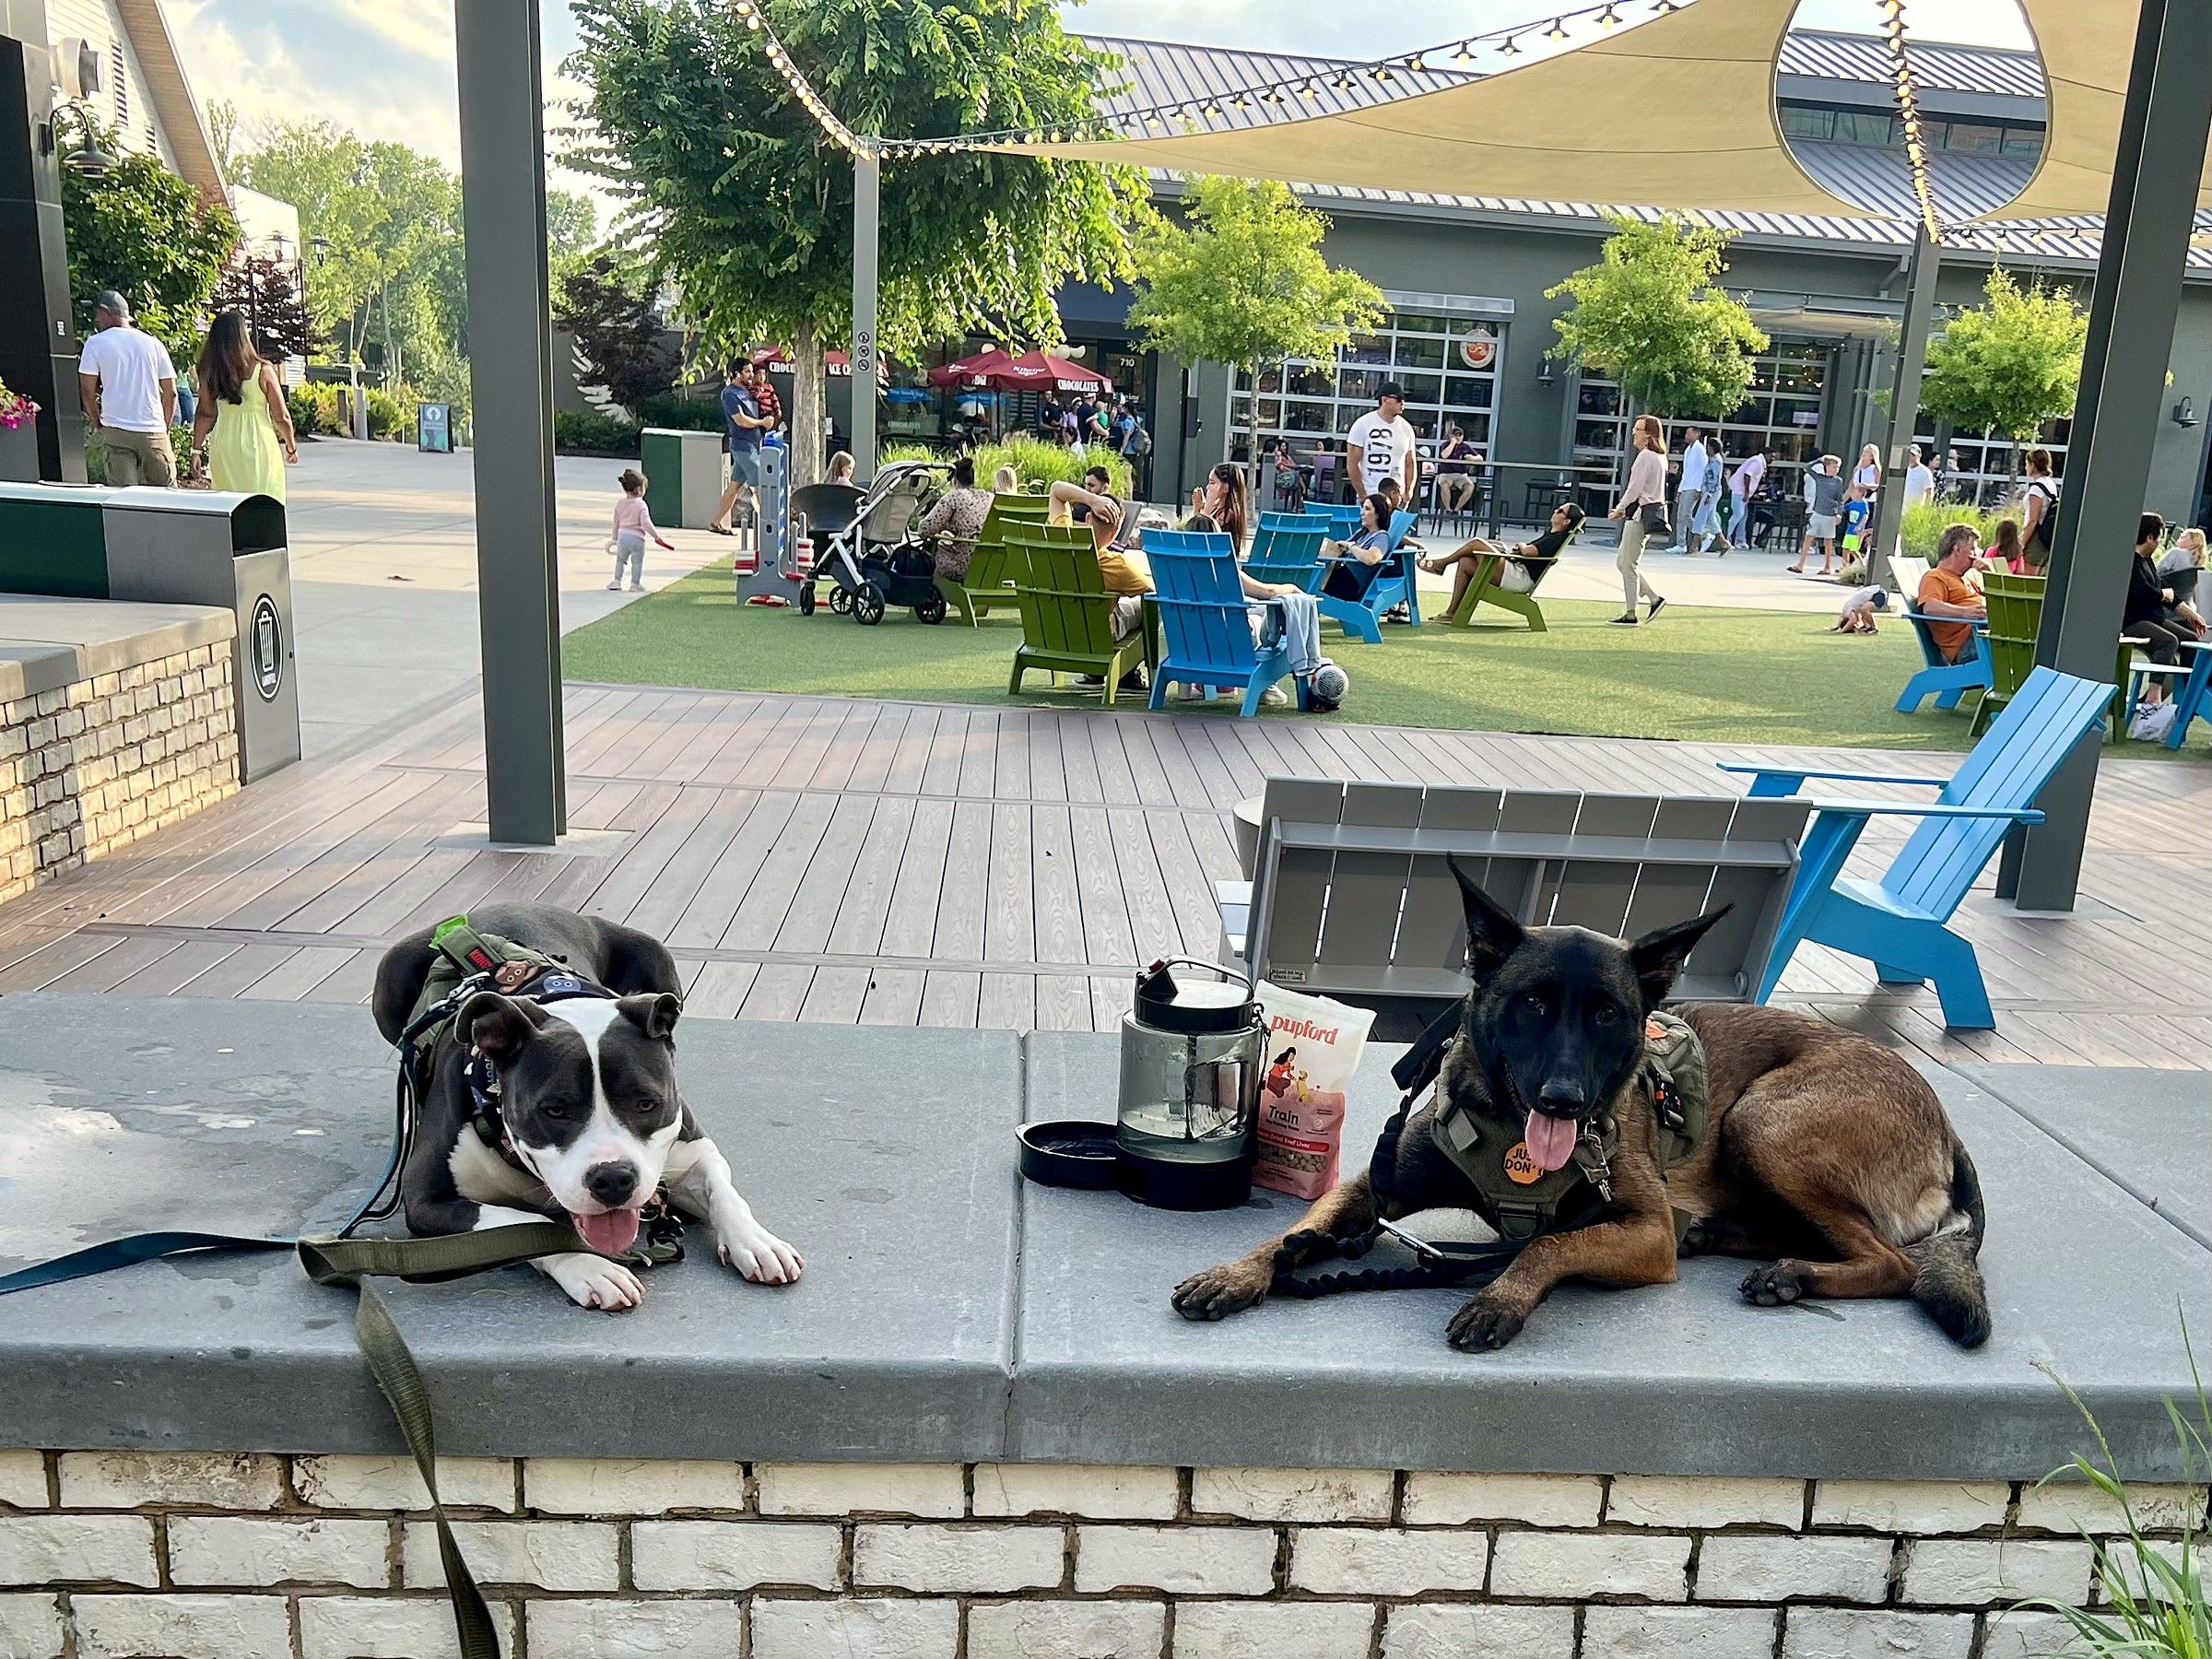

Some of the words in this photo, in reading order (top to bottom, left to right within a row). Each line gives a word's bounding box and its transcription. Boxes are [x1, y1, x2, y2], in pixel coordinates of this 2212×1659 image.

[1120, 358, 1135, 367] 710
[1057, 379, 1100, 393] CHOCOLATES
[1367, 429, 1393, 476] 1978
[1271, 1016, 1338, 1044] pupford
[1269, 1105, 1299, 1124] Train
[1512, 1148, 1532, 1161] JU
